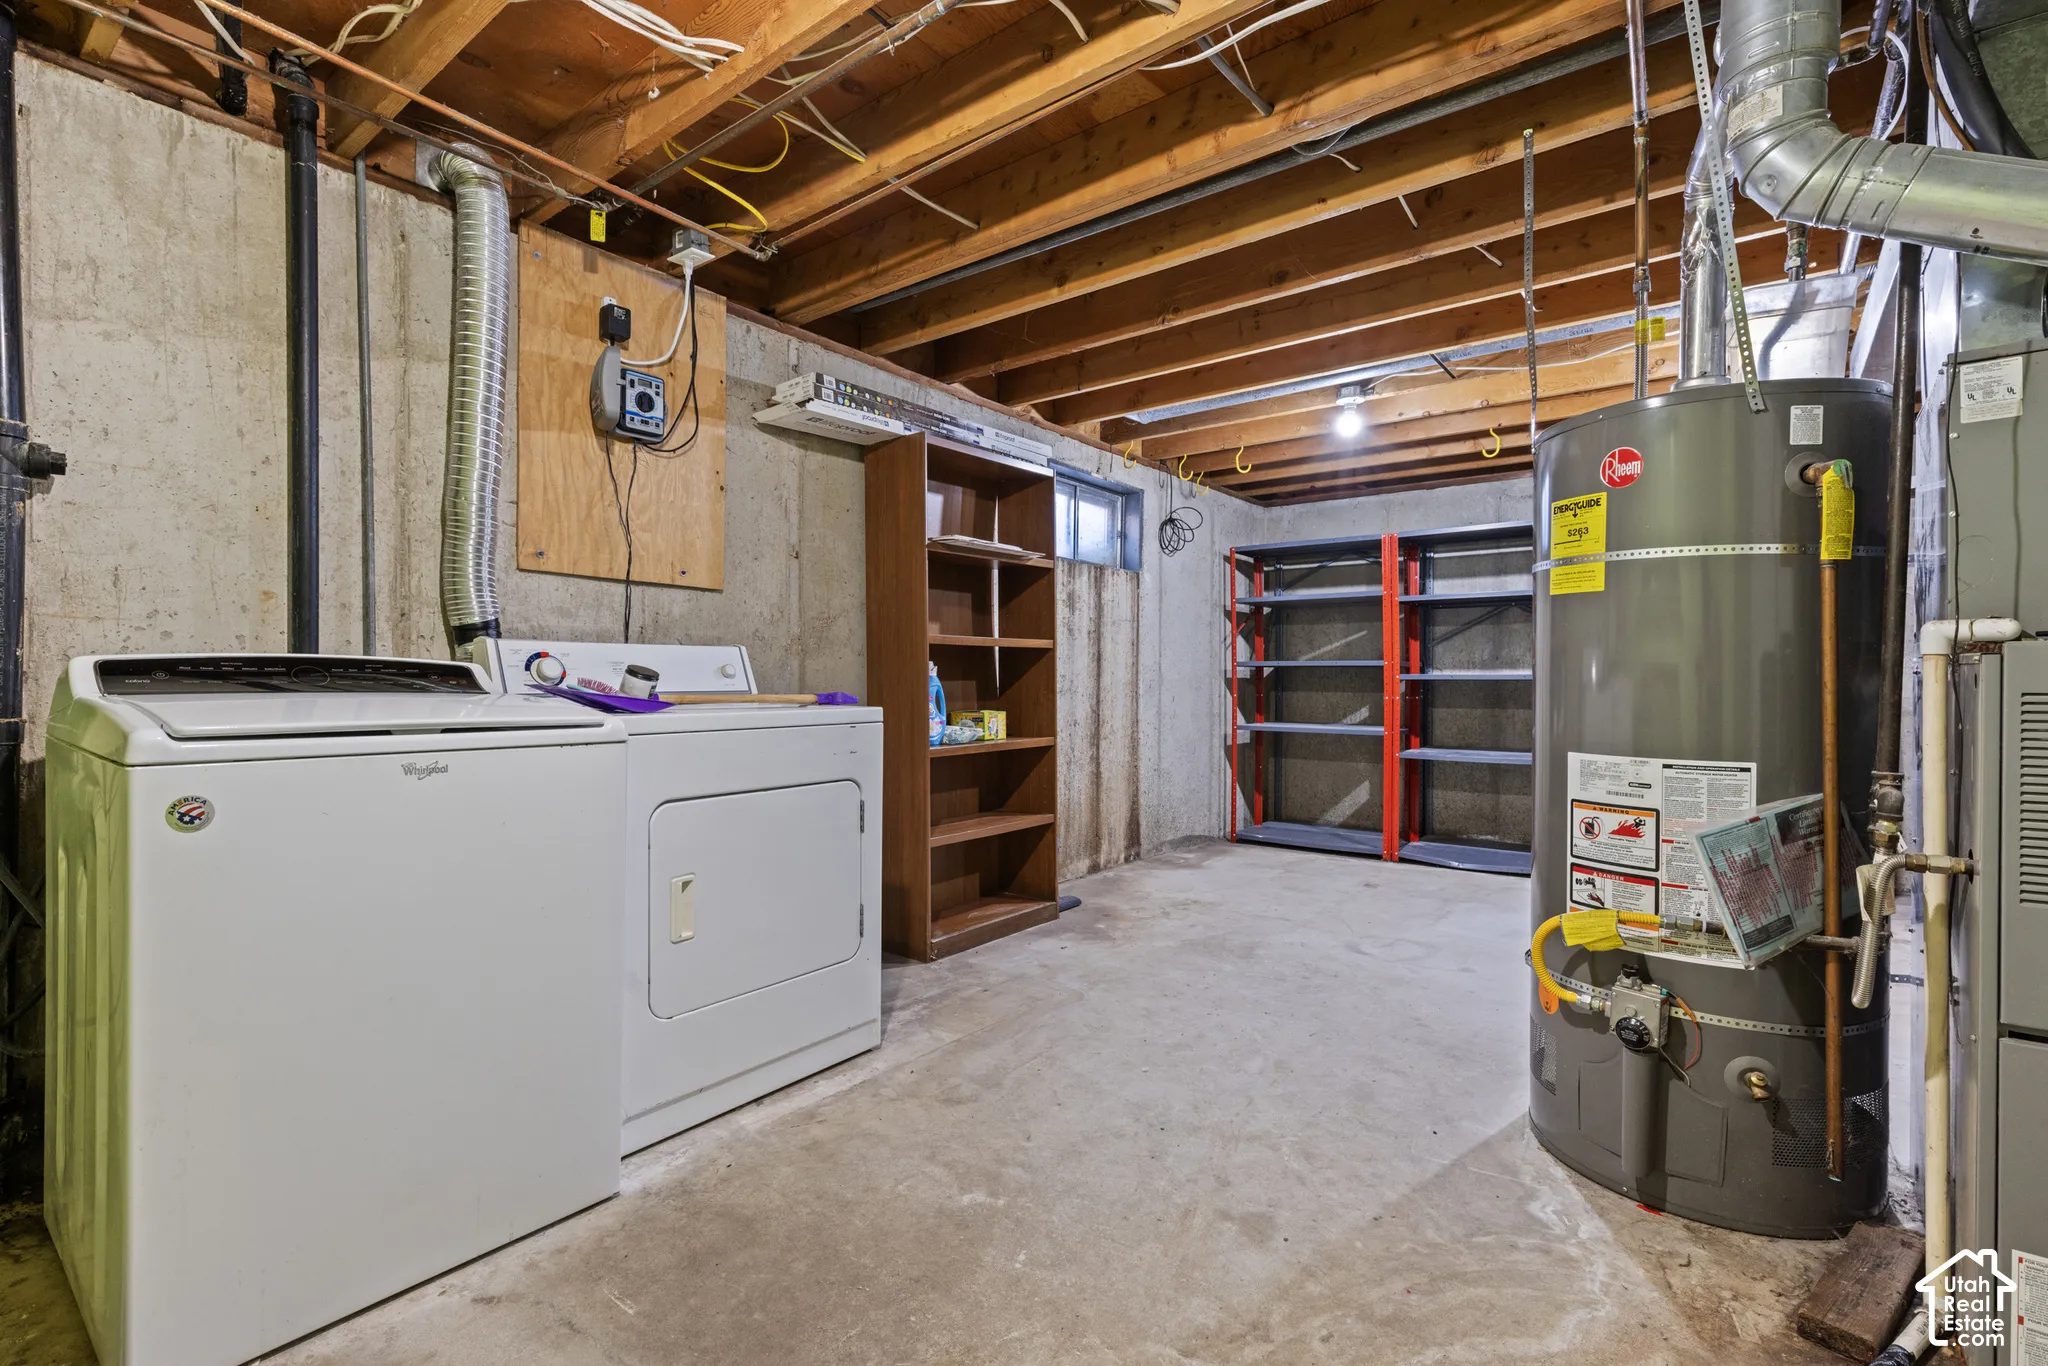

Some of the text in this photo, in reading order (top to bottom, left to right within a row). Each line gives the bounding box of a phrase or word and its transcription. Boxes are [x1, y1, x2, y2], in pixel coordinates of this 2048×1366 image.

[1605, 450, 1641, 482] Rheem
[1567, 526, 1589, 538] $263
[401, 761, 449, 779] Whirlpool
[168, 796, 207, 816] AMERICA
[1599, 807, 1630, 815] WARNING
[1598, 872, 1625, 881] DANGER
